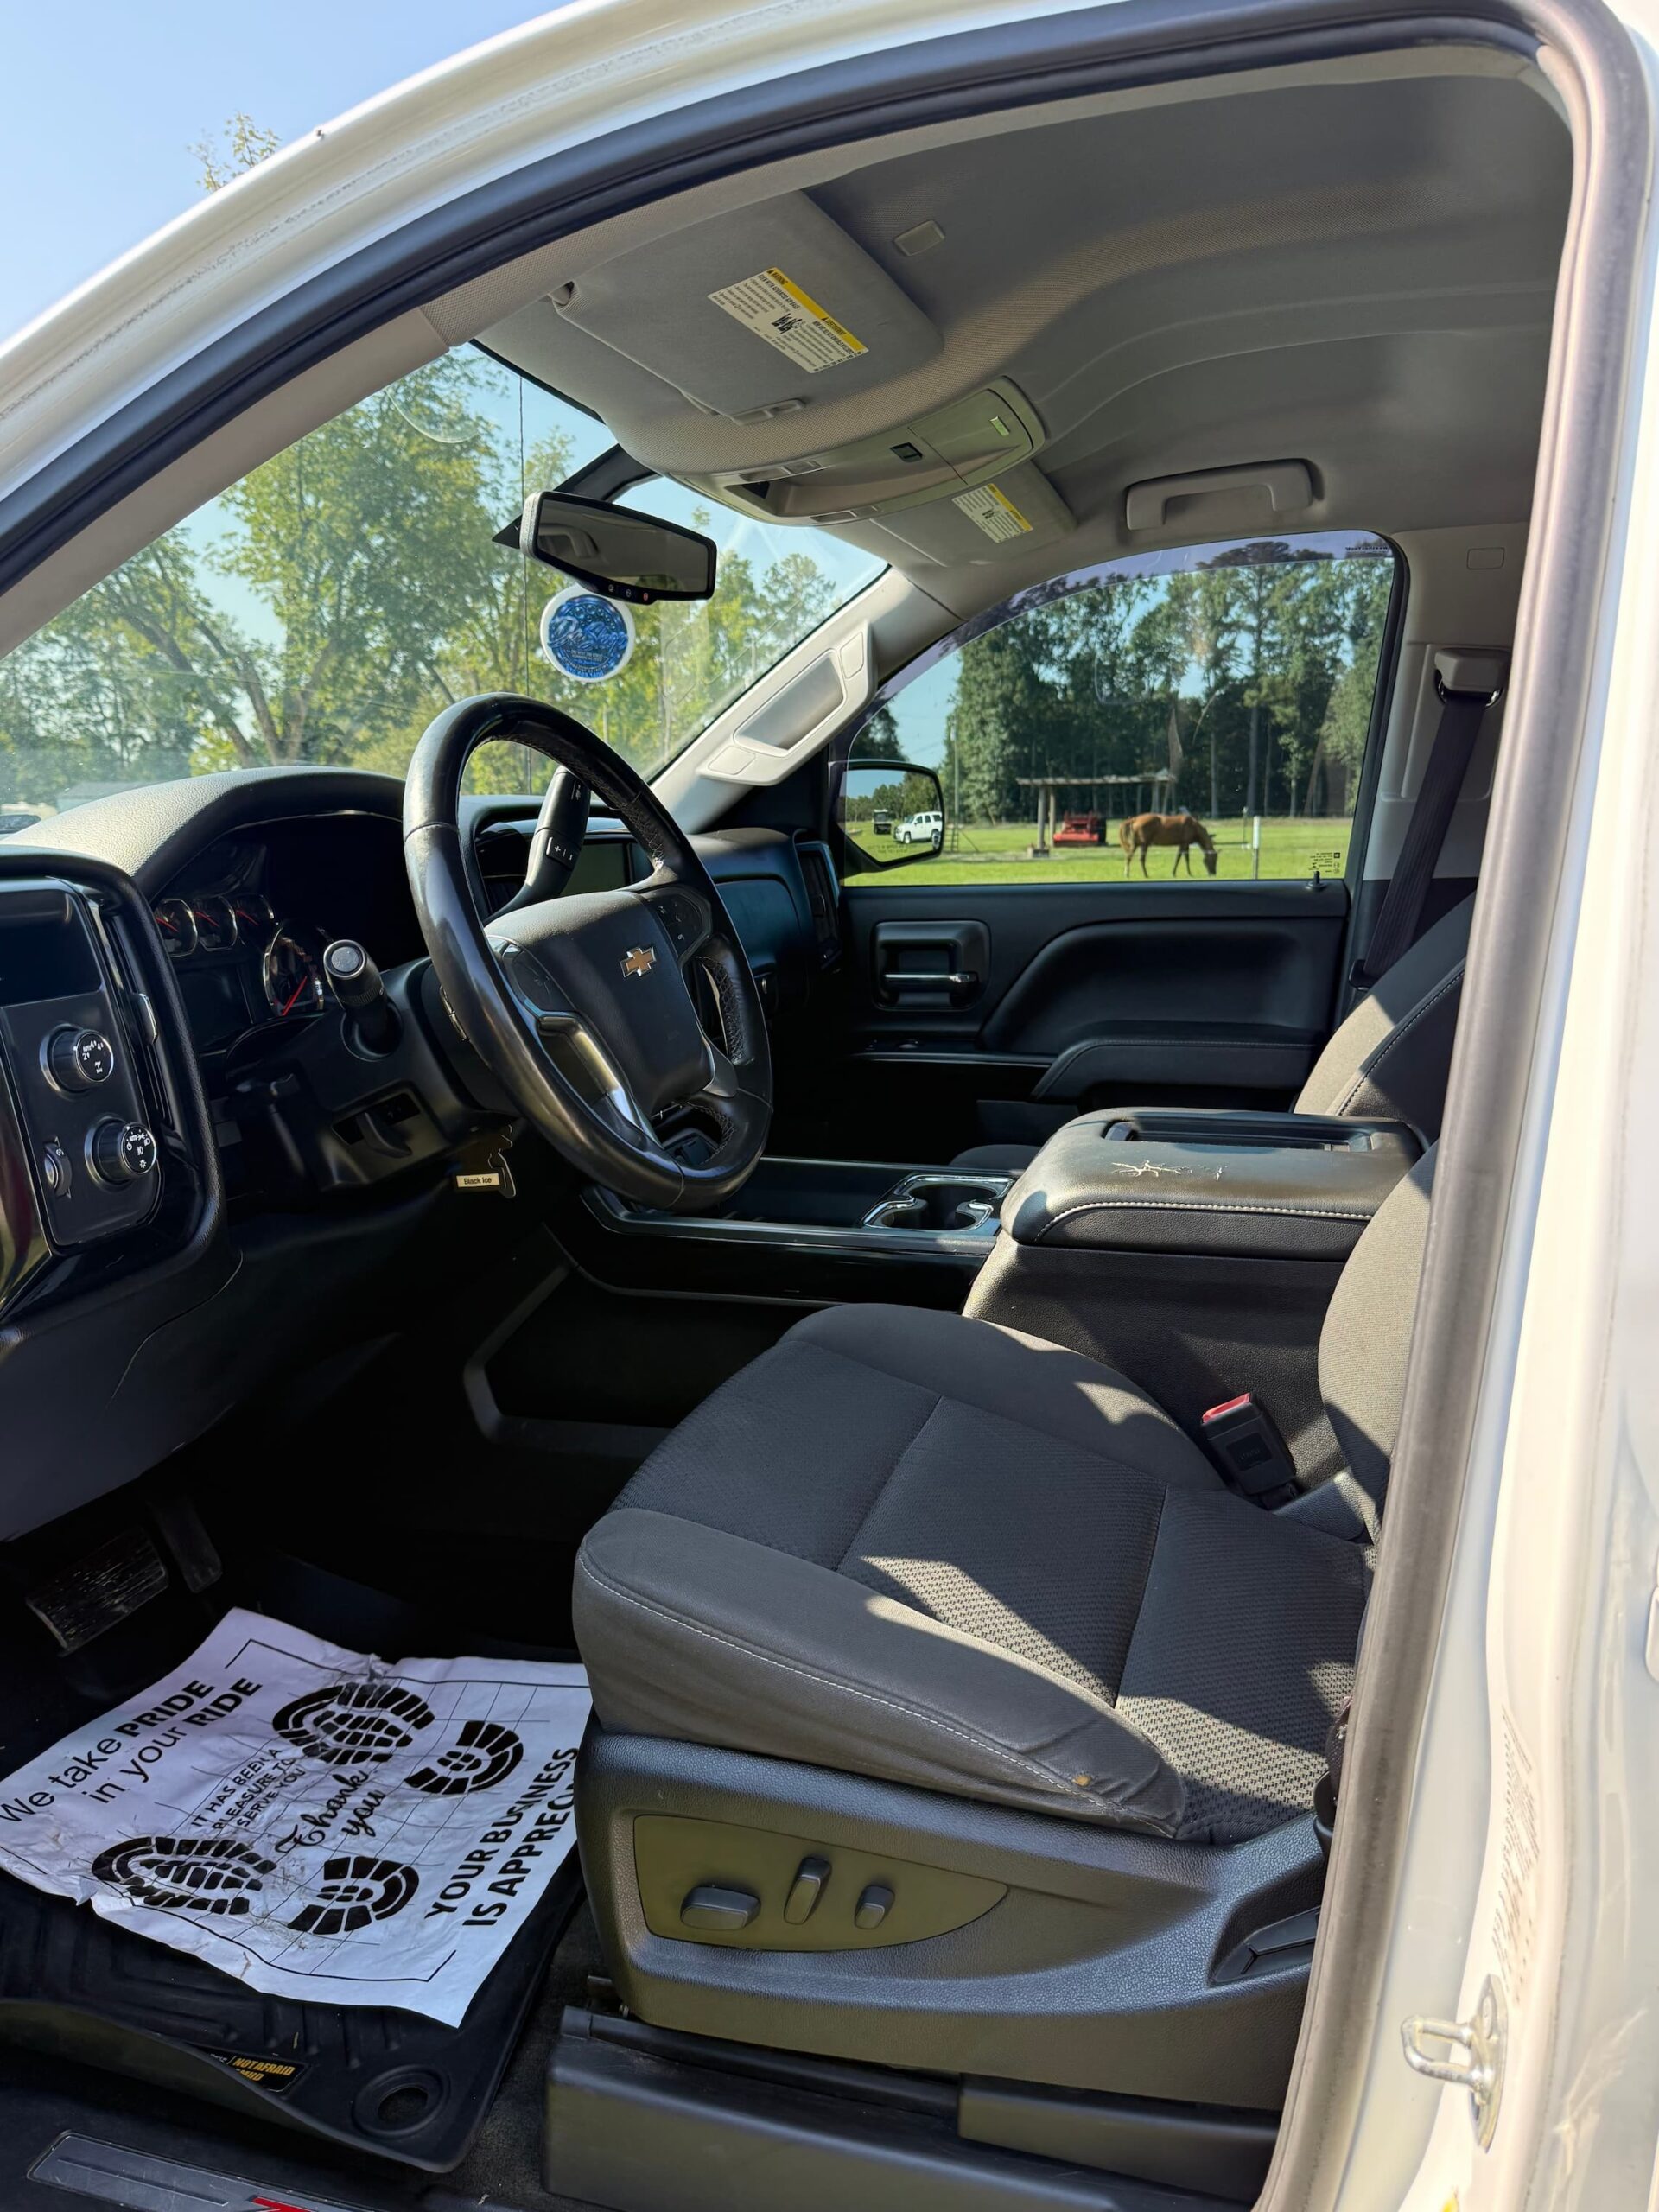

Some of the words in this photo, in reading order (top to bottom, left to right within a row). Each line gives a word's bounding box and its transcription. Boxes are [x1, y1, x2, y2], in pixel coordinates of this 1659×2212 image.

[0, 1791, 54, 1823] We
[48, 1738, 122, 1789] take
[113, 1680, 215, 1738] PRIDE
[82, 1781, 125, 1804] in
[120, 1726, 187, 1783] your
[182, 1678, 263, 1726] RIDE
[191, 1814, 208, 1827] IT
[205, 1785, 236, 1813] HAS
[268, 1748, 283, 1759] A
[212, 1773, 278, 1830] PLEASURE
[272, 1758, 296, 1775] TO
[237, 1791, 279, 1827] SERVE
[275, 1768, 306, 1789] YOU
[275, 1770, 369, 1853] Thank
[341, 1789, 386, 1838] you
[424, 1848, 500, 1919] YOUR
[479, 1747, 580, 1844] BUSINESS
[462, 1902, 508, 1926] IS
[487, 1782, 575, 1897] APPREC
